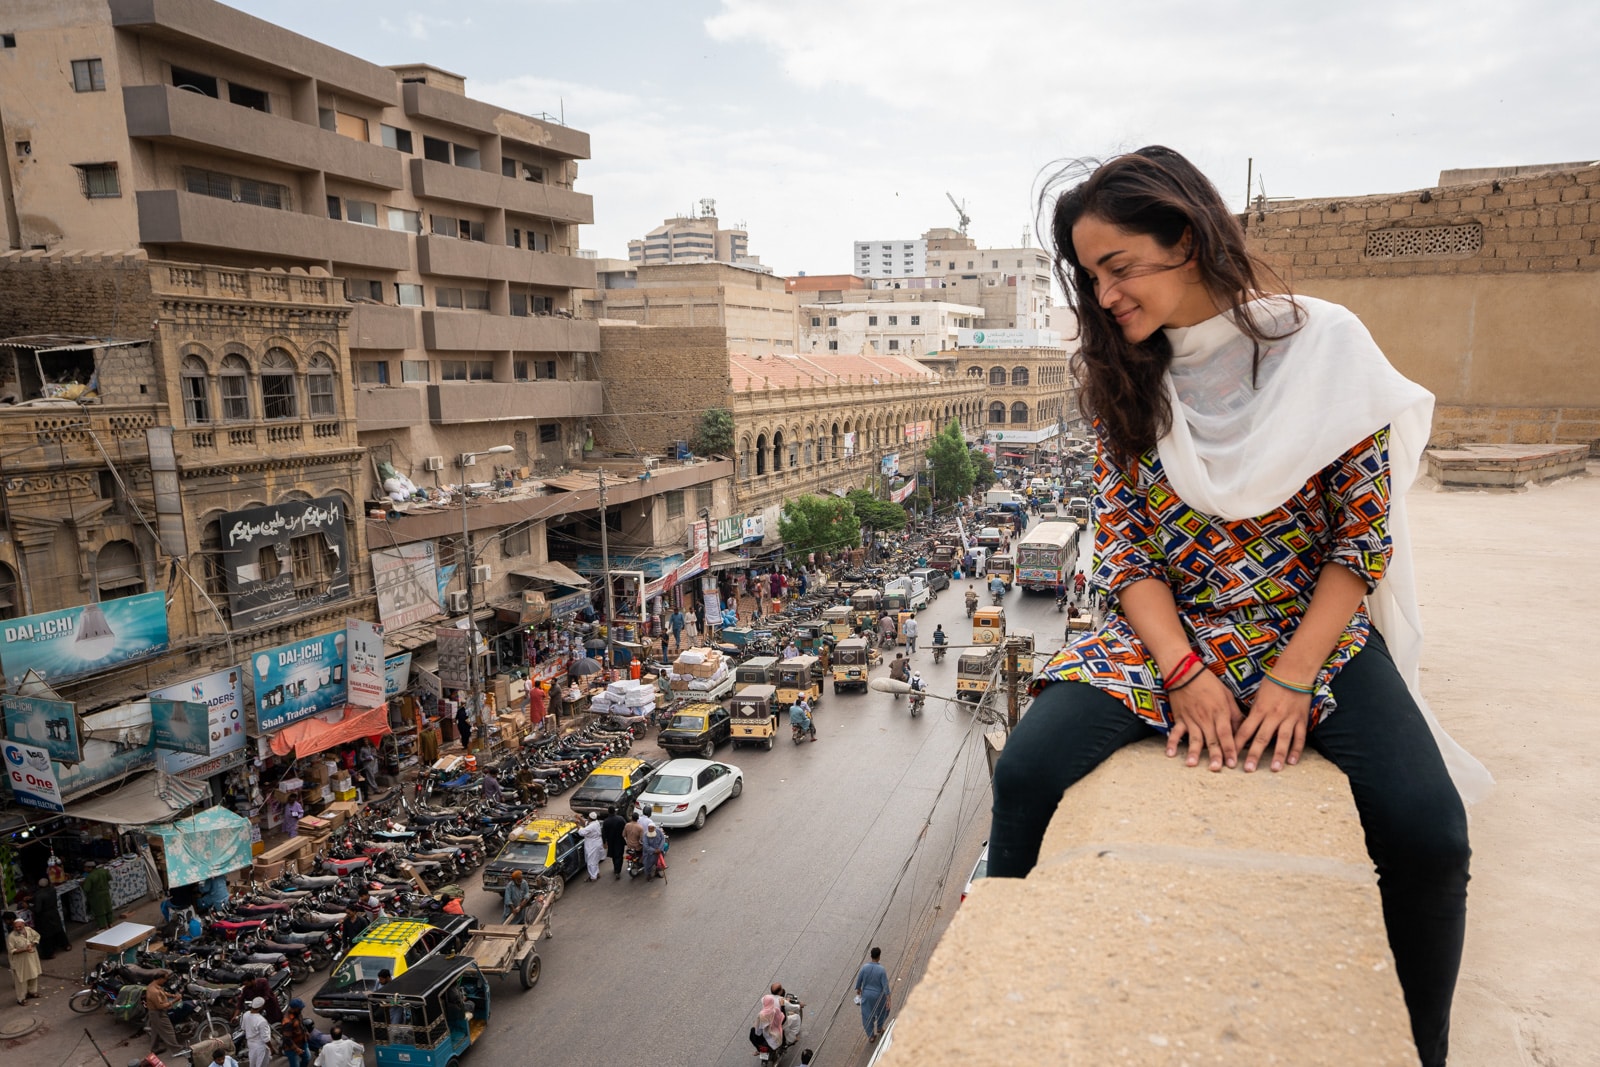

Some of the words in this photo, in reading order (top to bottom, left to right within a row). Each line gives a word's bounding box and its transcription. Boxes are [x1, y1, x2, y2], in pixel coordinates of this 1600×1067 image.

[5, 616, 74, 643] DAI-ICHI
[32, 630, 74, 643] LIGHTING
[279, 642, 323, 666] DAI-ICHI
[362, 682, 383, 692] TRADERS
[6, 700, 33, 713] DAI-ICHI
[261, 713, 284, 730] Shah
[285, 704, 317, 721] Traders
[188, 759, 221, 778] TRADERS
[11, 771, 23, 783] G
[26, 773, 54, 789] One
